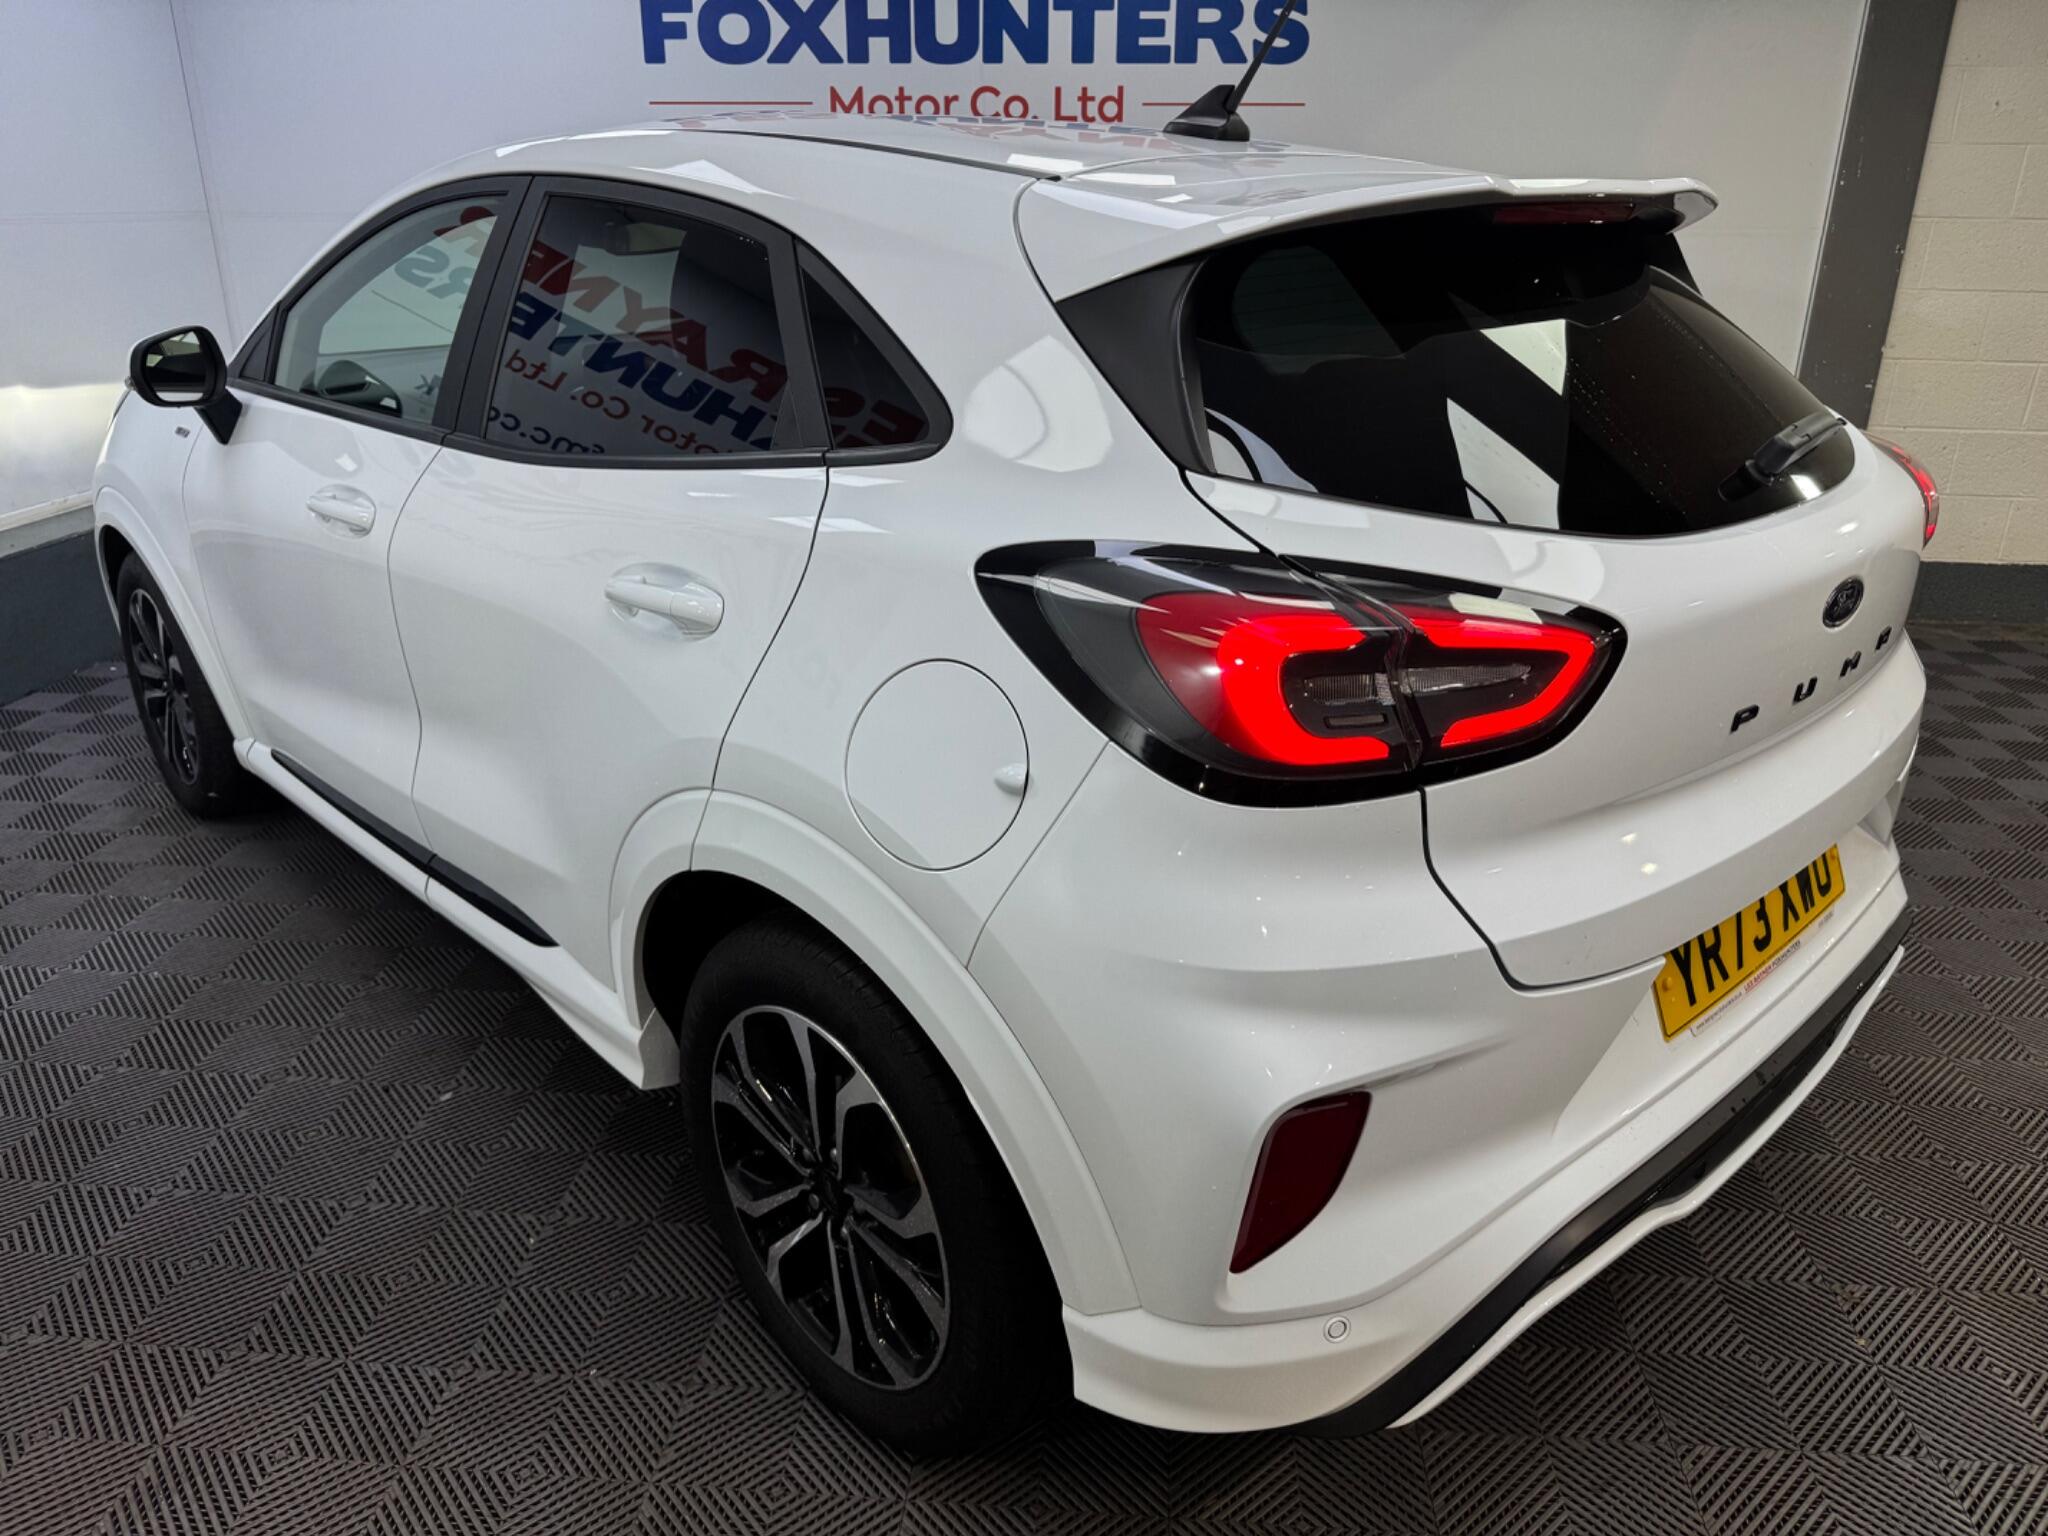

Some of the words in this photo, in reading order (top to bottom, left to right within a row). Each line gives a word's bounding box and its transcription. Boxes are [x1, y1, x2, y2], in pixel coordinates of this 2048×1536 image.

[641, 0, 1310, 64] FOXHUNTERS
[829, 86, 960, 115] Motor
[970, 85, 1039, 120] Co.
[1054, 85, 1125, 123] Ltd
[1669, 896, 1772, 1007] YR73
